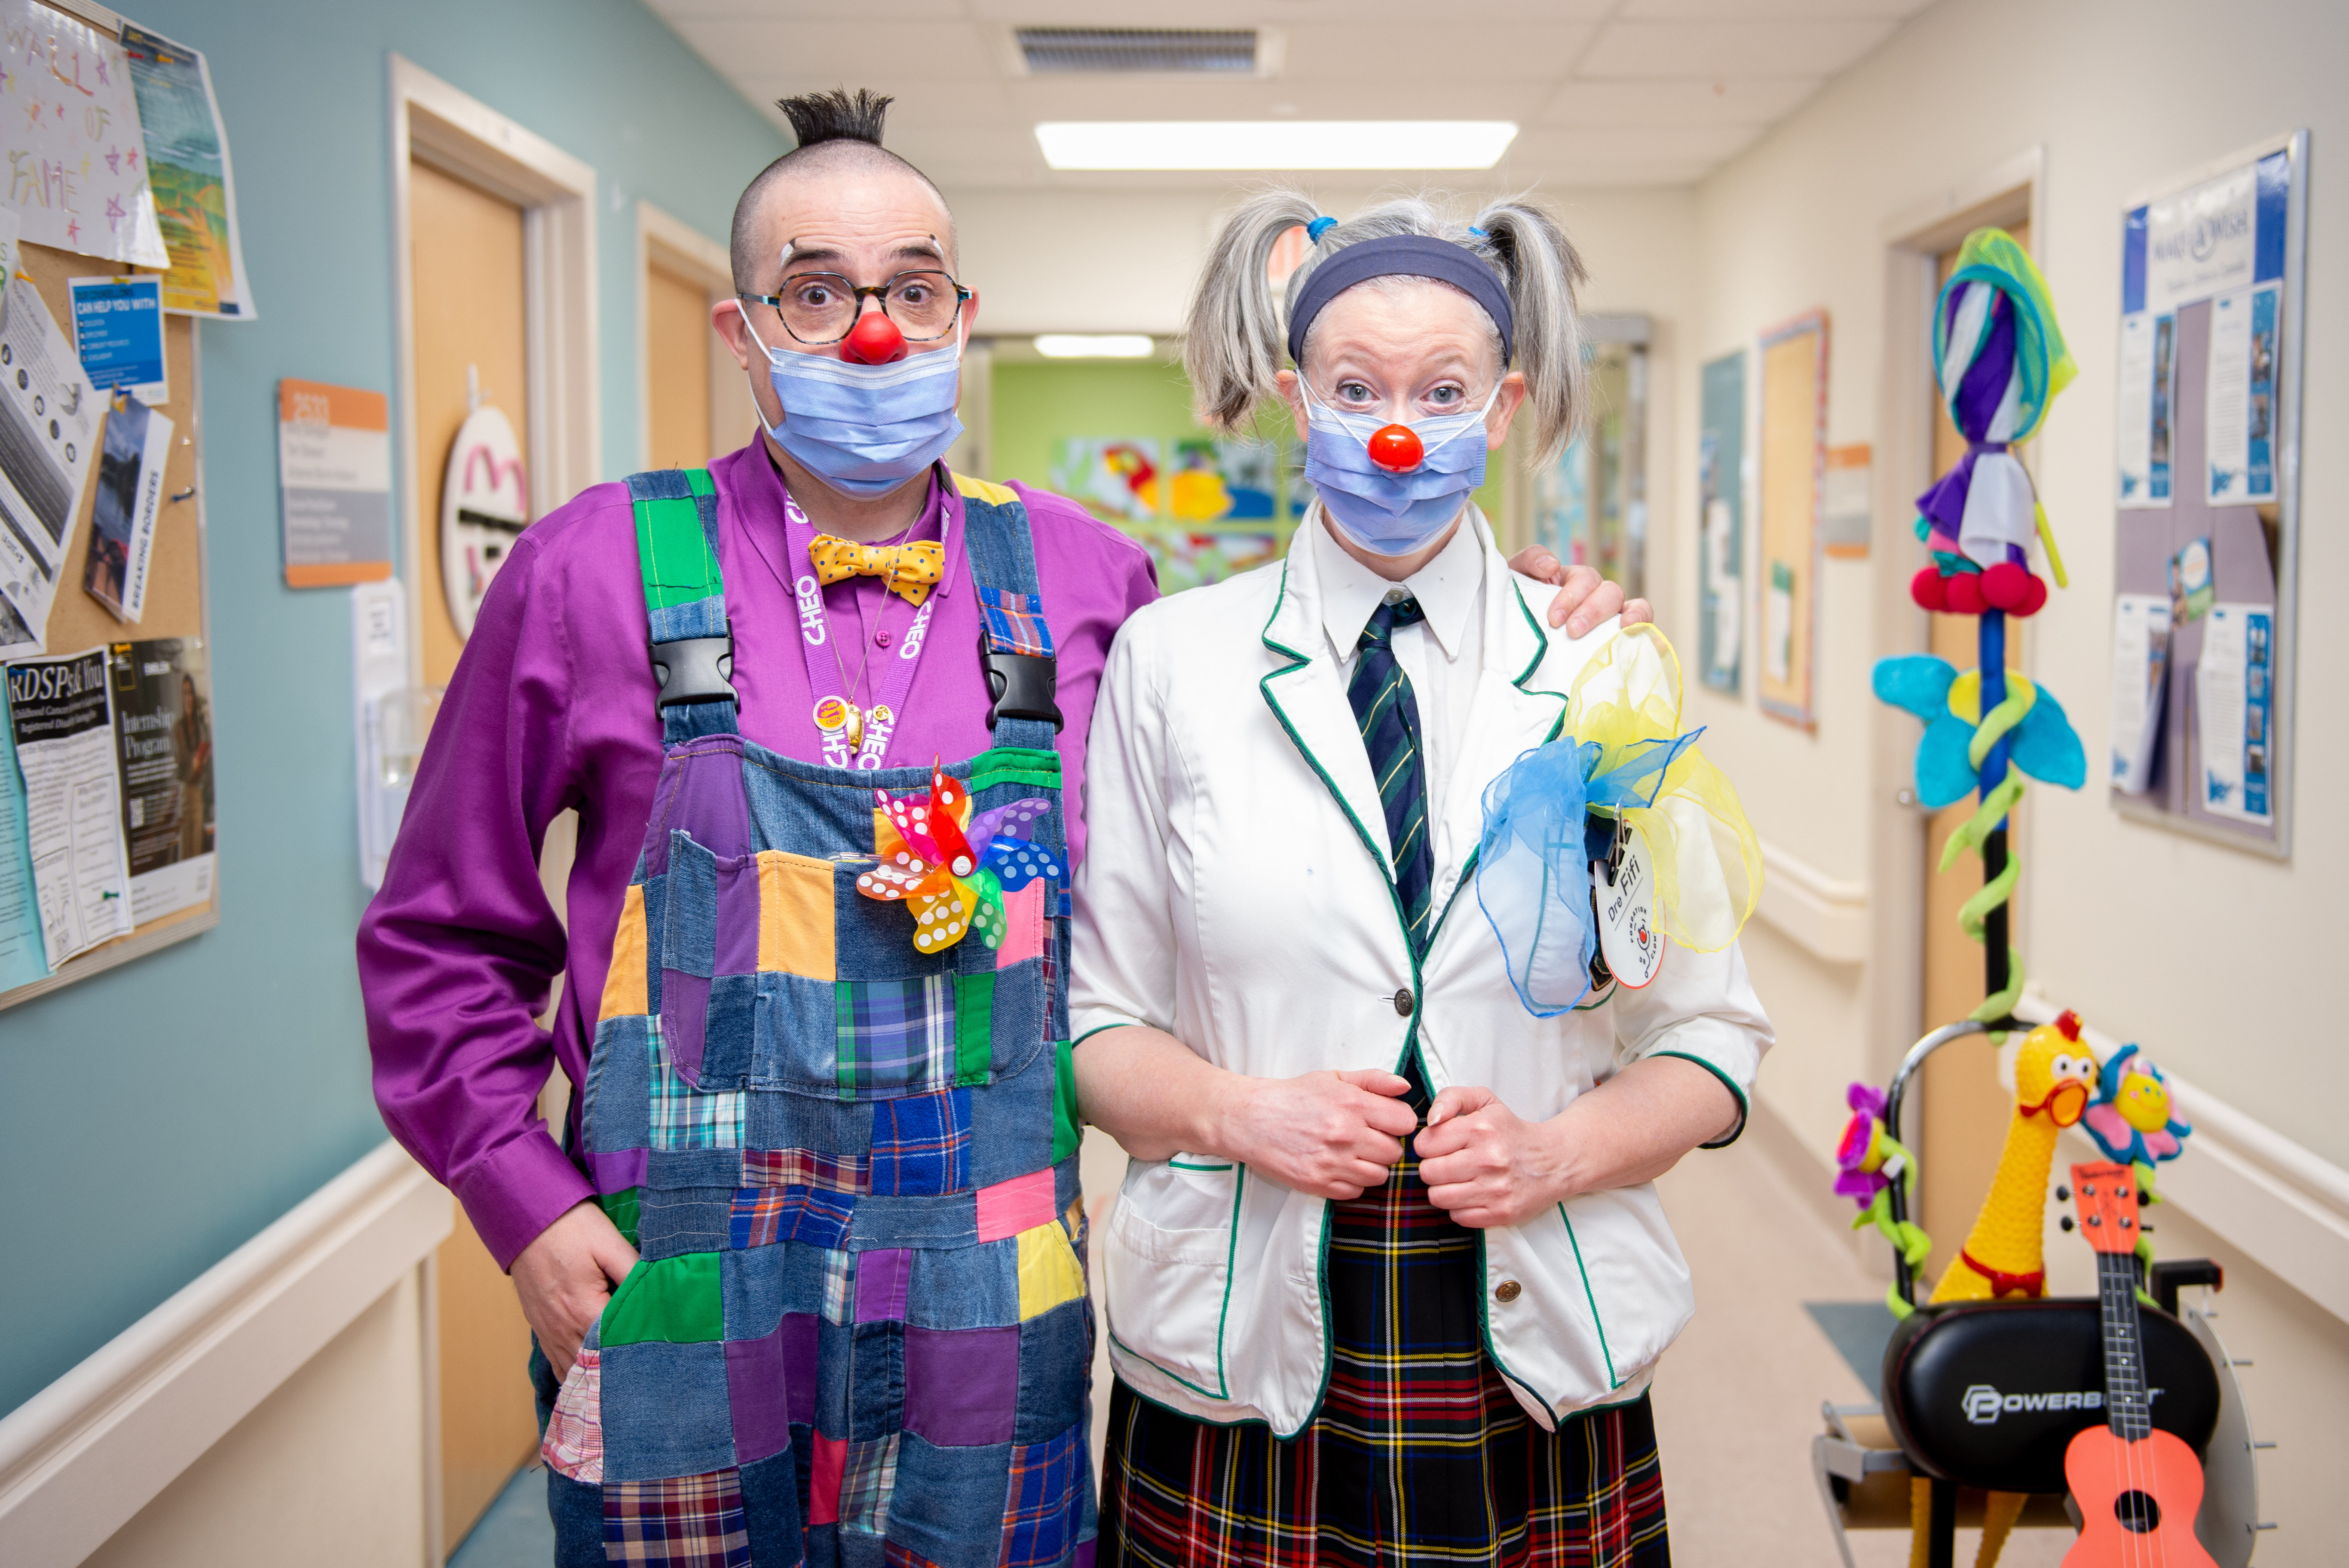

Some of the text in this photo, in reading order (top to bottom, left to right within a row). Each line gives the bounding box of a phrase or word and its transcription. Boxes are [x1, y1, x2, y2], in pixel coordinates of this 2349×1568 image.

[85, 105, 110, 142] OF
[8, 149, 80, 214] FAME
[77, 302, 93, 315] CAN
[93, 300, 111, 313] HELP
[112, 299, 131, 312] YOU
[785, 487, 809, 524] CH
[796, 575, 826, 646] CHEO
[899, 600, 931, 659] CHEO
[83, 658, 104, 690] You
[122, 706, 175, 734] Internship
[125, 734, 170, 759] Program
[1608, 854, 1640, 922] Dre Fifi
[1629, 906, 1647, 943] FONDATION
[1639, 956, 1646, 965] DR
[1962, 1384, 2160, 1424] POWERBT
